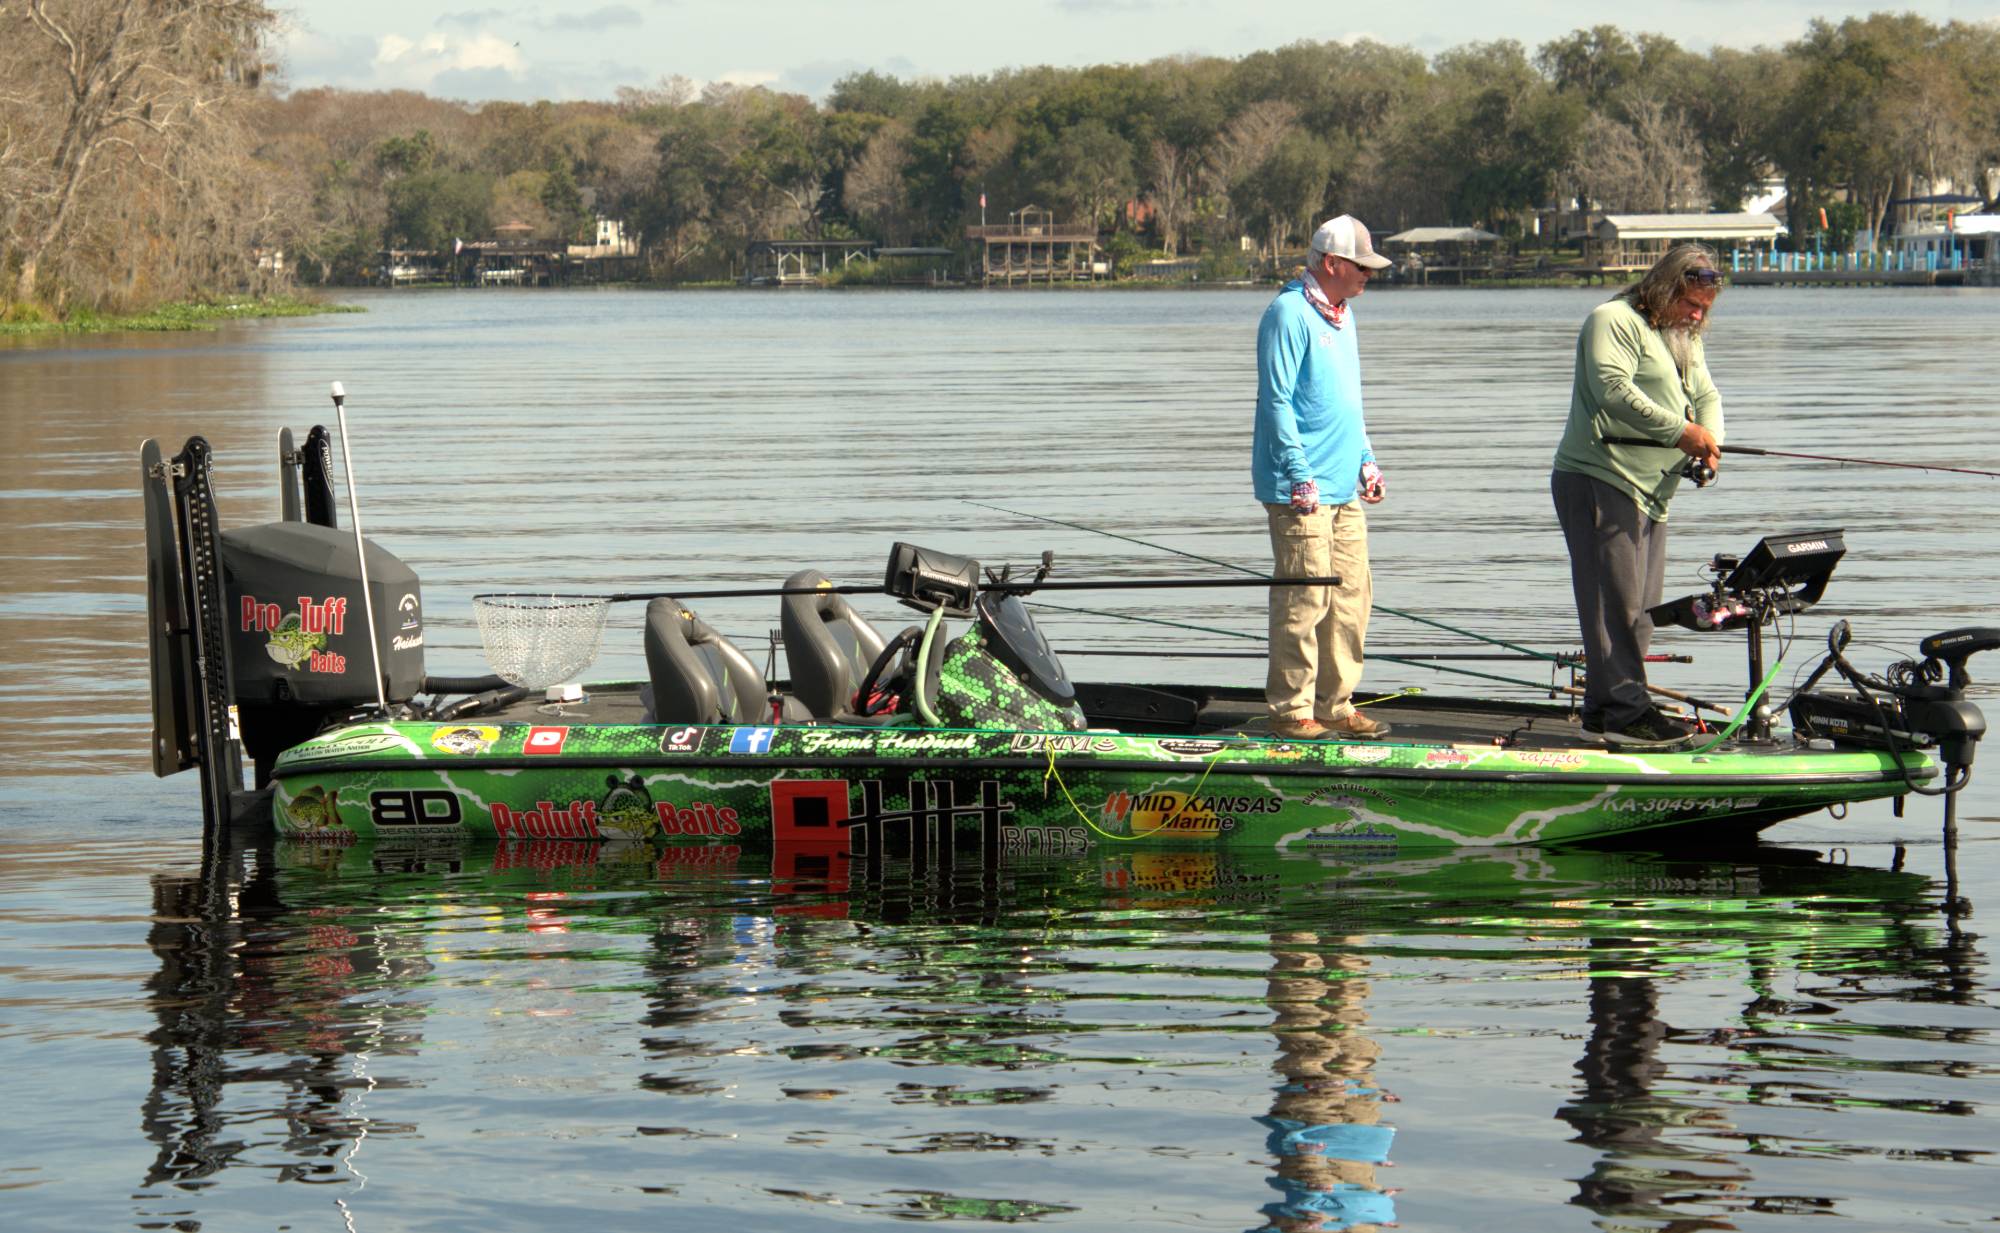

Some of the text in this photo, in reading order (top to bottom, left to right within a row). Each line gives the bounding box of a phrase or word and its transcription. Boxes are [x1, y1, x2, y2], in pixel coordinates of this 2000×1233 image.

[1787, 540, 1828, 553] GARMIN
[241, 595, 347, 635] Pro Tuff
[310, 649, 346, 673] Baits
[803, 731, 874, 753] Frank
[1130, 795, 1282, 813] MID KANSAS
[489, 801, 600, 840] ProTuff
[655, 801, 741, 836] Baits
[1161, 813, 1234, 831] Marine
